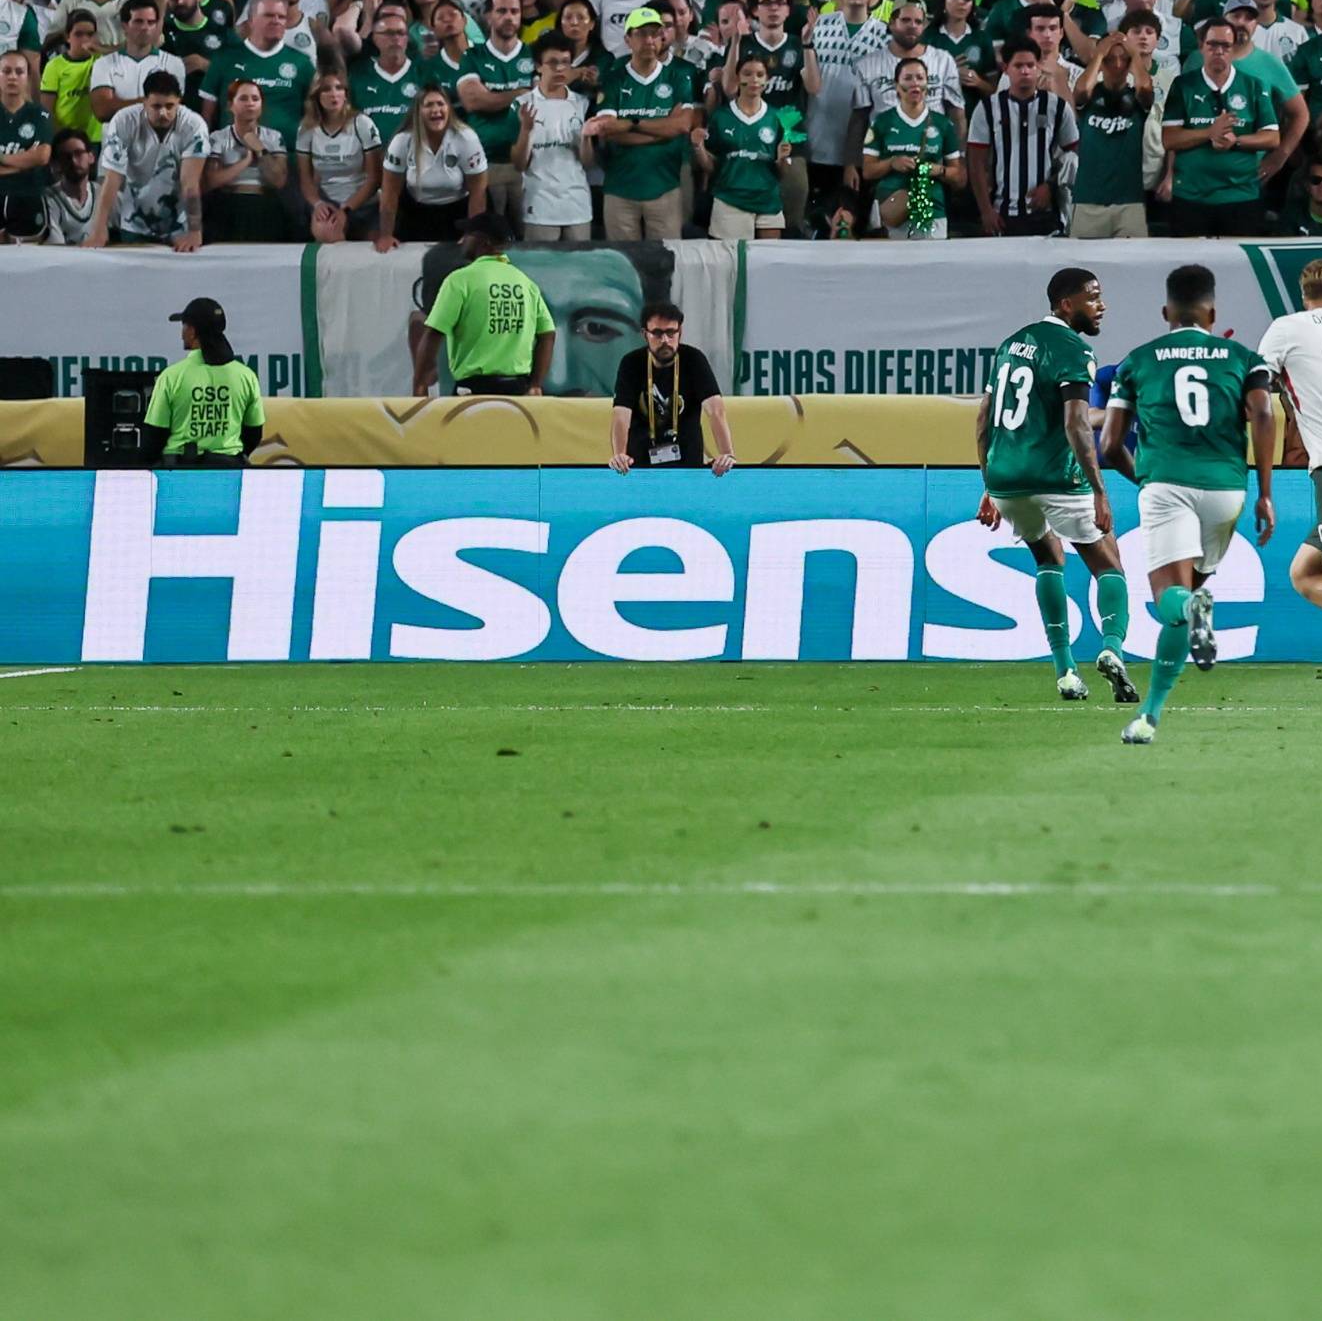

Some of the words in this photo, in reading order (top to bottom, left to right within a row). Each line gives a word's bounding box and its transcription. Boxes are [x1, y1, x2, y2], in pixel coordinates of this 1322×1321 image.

[488, 283, 524, 300] CSC
[488, 301, 525, 318] EVENT
[488, 317, 525, 335] STAFF
[1008, 341, 1038, 361] MICAEL
[1154, 346, 1230, 362] VANDERLAN
[190, 385, 231, 402] CSC
[993, 362, 1035, 431] 13
[1174, 364, 1211, 428] 6
[190, 403, 231, 421] EVENT
[189, 420, 230, 439] STAFF
[81, 468, 1269, 663] Hisense
